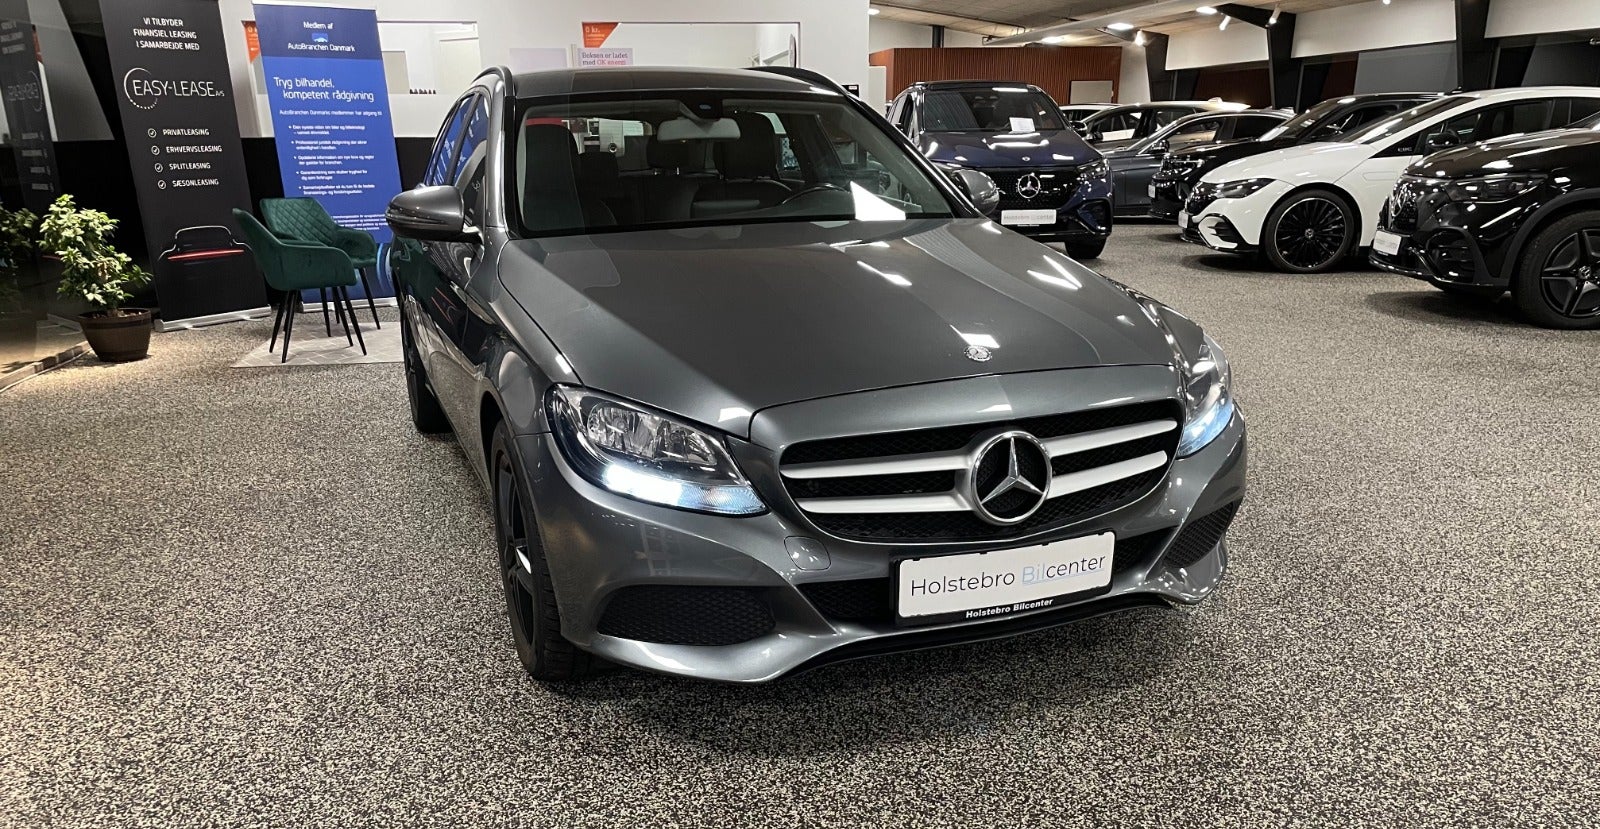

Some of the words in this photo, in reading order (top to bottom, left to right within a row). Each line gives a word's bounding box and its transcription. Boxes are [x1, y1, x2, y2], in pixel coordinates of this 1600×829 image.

[143, 17, 151, 25] VI
[152, 17, 184, 26] TILBYDER
[303, 21, 327, 29] Medlem
[133, 29, 169, 37] FINANSIEL
[170, 30, 197, 39] LEASING
[140, 41, 184, 50] SAMARBEJDE
[185, 43, 200, 51] MED
[288, 43, 329, 51] AutoBranchen
[330, 44, 356, 52] Danmark
[273, 76, 292, 89] Tryg
[132, 80, 216, 97] EASY-LEASE
[283, 90, 330, 100] kompetent
[332, 89, 375, 102] rådgivning
[162, 128, 210, 136] PRIVATLEASING
[165, 145, 223, 153] ERHVERVSLEASING
[168, 162, 211, 170] SPLITLEASING
[172, 179, 219, 187] SÆSONLEASING
[911, 572, 1015, 597] Holstebro
[1021, 555, 1106, 584] Bilcenter
[965, 605, 1011, 619] Holstebro
[1013, 599, 1053, 611] Bilcenter
